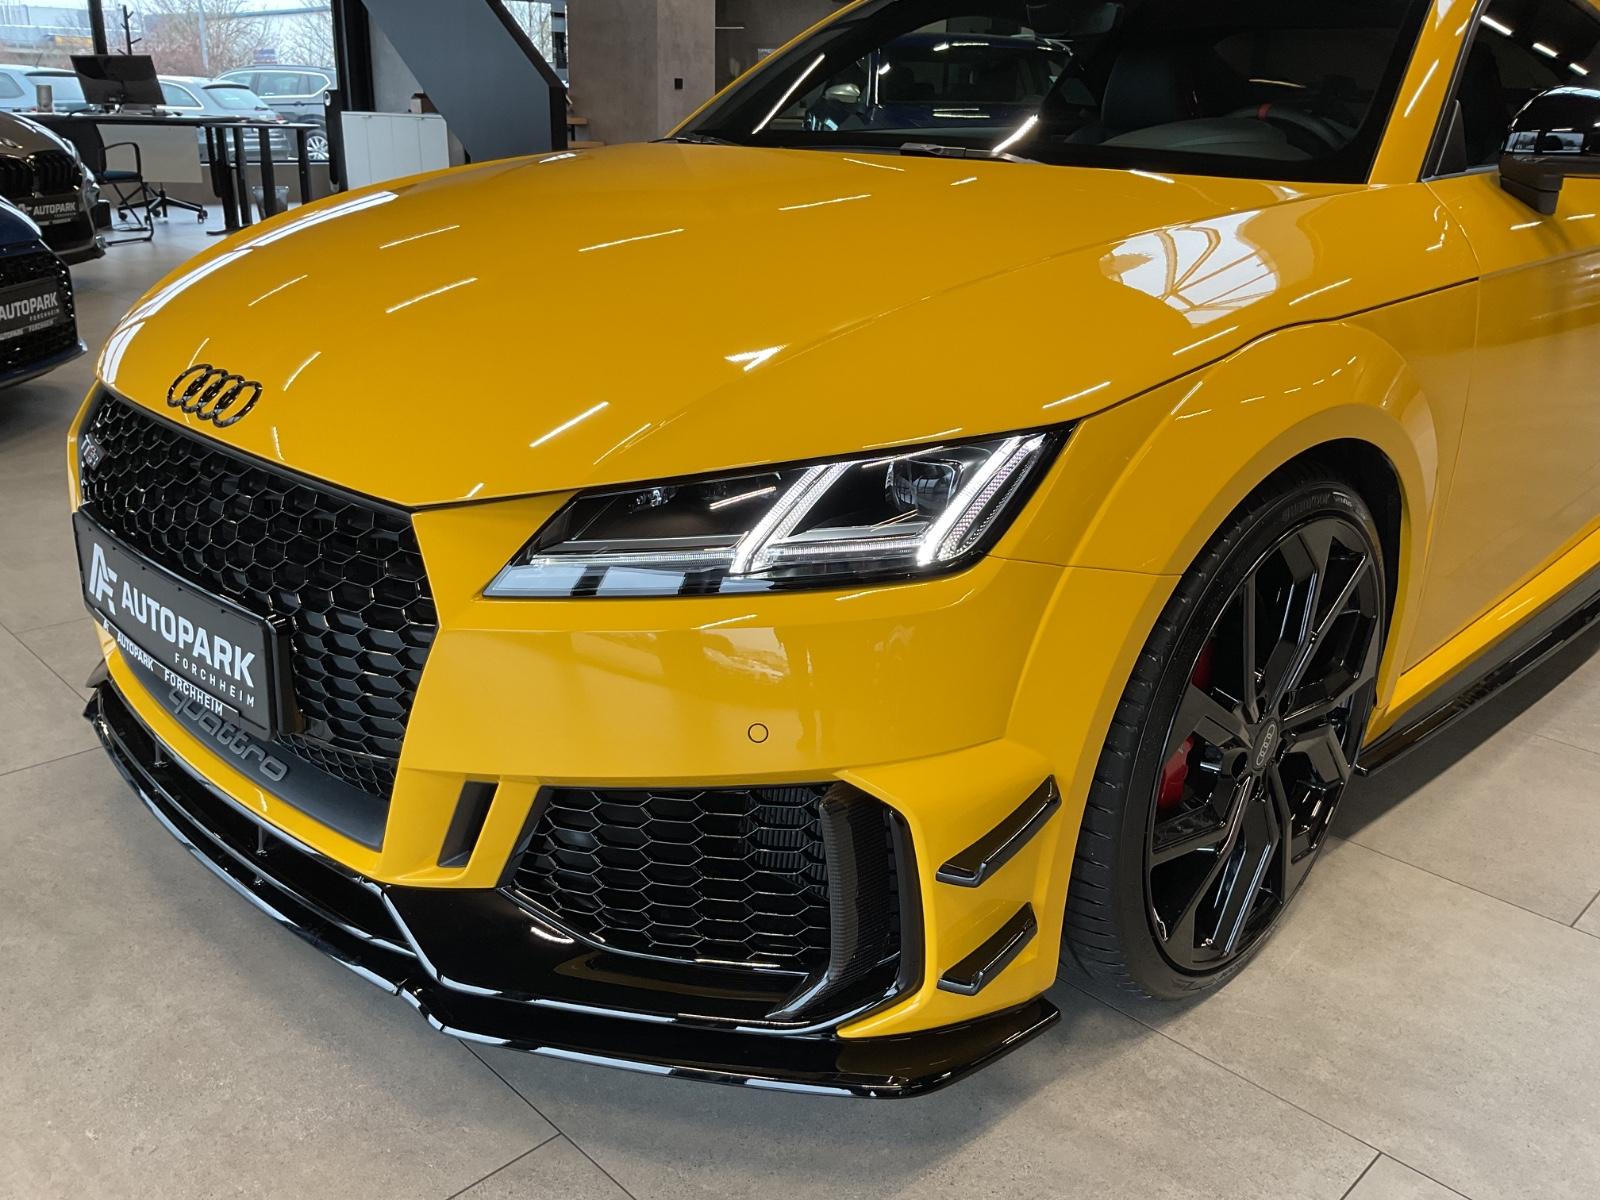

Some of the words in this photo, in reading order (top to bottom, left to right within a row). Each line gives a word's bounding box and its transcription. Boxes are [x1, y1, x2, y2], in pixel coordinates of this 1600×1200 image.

[33, 201, 76, 216] AUTOPARK
[0, 291, 58, 321] AUTOPARK
[121, 580, 255, 688] AUTOPARK
[117, 631, 154, 672] AUTOPARK
[164, 668, 224, 716] FORCHHEIM
[174, 652, 255, 708] FORCHHEIM
[168, 688, 288, 781] quattro
